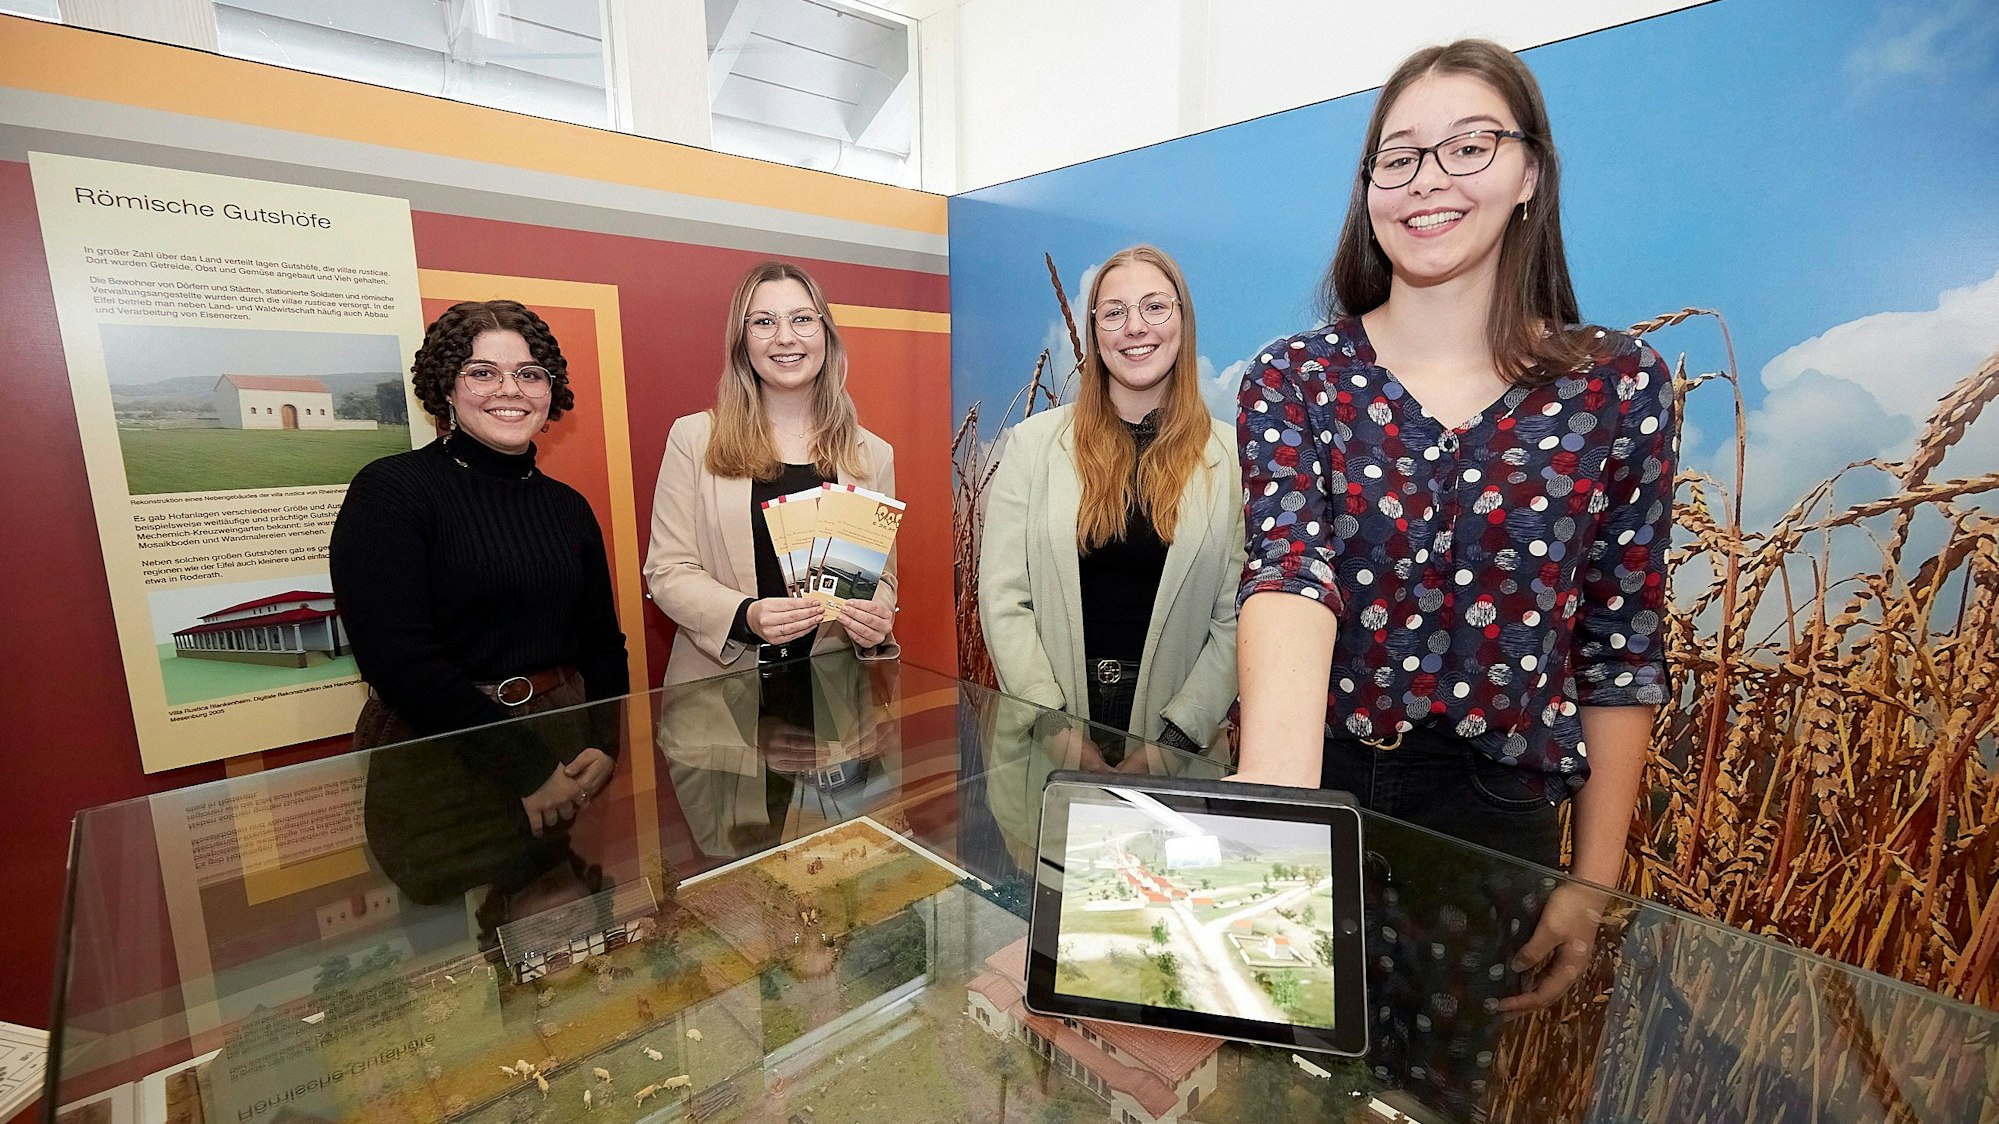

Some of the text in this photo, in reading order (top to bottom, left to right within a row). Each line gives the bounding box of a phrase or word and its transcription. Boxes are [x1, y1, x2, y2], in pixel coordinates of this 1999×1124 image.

[74, 187, 331, 229] Römische Gutshöfe
[84, 246, 94, 254] In
[97, 248, 129, 257] großer
[132, 249, 154, 258] Zahl
[156, 252, 177, 260] über
[181, 254, 197, 262] das
[200, 255, 222, 264] Land
[224, 257, 254, 266] verteilt
[256, 260, 279, 270] lagen
[323, 265, 336, 273] die
[337, 266, 356, 274] villae
[86, 256, 108, 264] Dort
[110, 259, 147, 267] wurden
[150, 261, 192, 271] Getreide,
[196, 264, 217, 272] Obst
[220, 266, 236, 274] und
[238, 268, 274, 277] Gemüse
[276, 270, 316, 280] angebaut
[318, 273, 332, 281] und
[334, 274, 352, 282] Vieh
[90, 276, 106, 284] Die
[108, 277, 156, 287] Bewohner
[177, 282, 209, 290] Dörfern
[211, 284, 227, 292] und
[266, 288, 308, 297] stationierte
[310, 290, 344, 299] Soldaten
[345, 292, 360, 300] und
[361, 294, 394, 302] römische
[91, 286, 202, 300] Verwaltungsangestellte
[204, 293, 238, 301] wurden
[240, 294, 264, 303] durch
[117, 307, 178, 318] Verarbeitung
[118, 298, 152, 306] betrieb
[208, 302, 234, 310] Land-
[236, 304, 252, 312] und
[254, 304, 315, 315] Waldwirtschaft
[318, 308, 342, 317] häufig
[344, 309, 362, 317] auch
[364, 310, 388, 318] Abbau
[135, 520, 202, 531] beispielsweise
[204, 517, 250, 526] weitläufige
[270, 514, 308, 522] prächtige
[310, 511, 339, 519] Gutshö
[148, 514, 166, 522] gab
[168, 510, 220, 520] Hofanlagen
[221, 507, 280, 516] verschiedener
[283, 505, 308, 513] Größe
[138, 540, 200, 550] Mosaikboden
[221, 532, 286, 542] Wandmalereien
[142, 559, 172, 567] Neben
[174, 556, 210, 564] solchen
[212, 552, 242, 562] großen
[244, 548, 287, 558] Gutshöfen
[289, 546, 304, 554] gab
[143, 567, 182, 576] regionen
[236, 560, 256, 568] auch
[258, 556, 289, 565] kleinere
[334, 679, 361, 688] Hauptgeb
